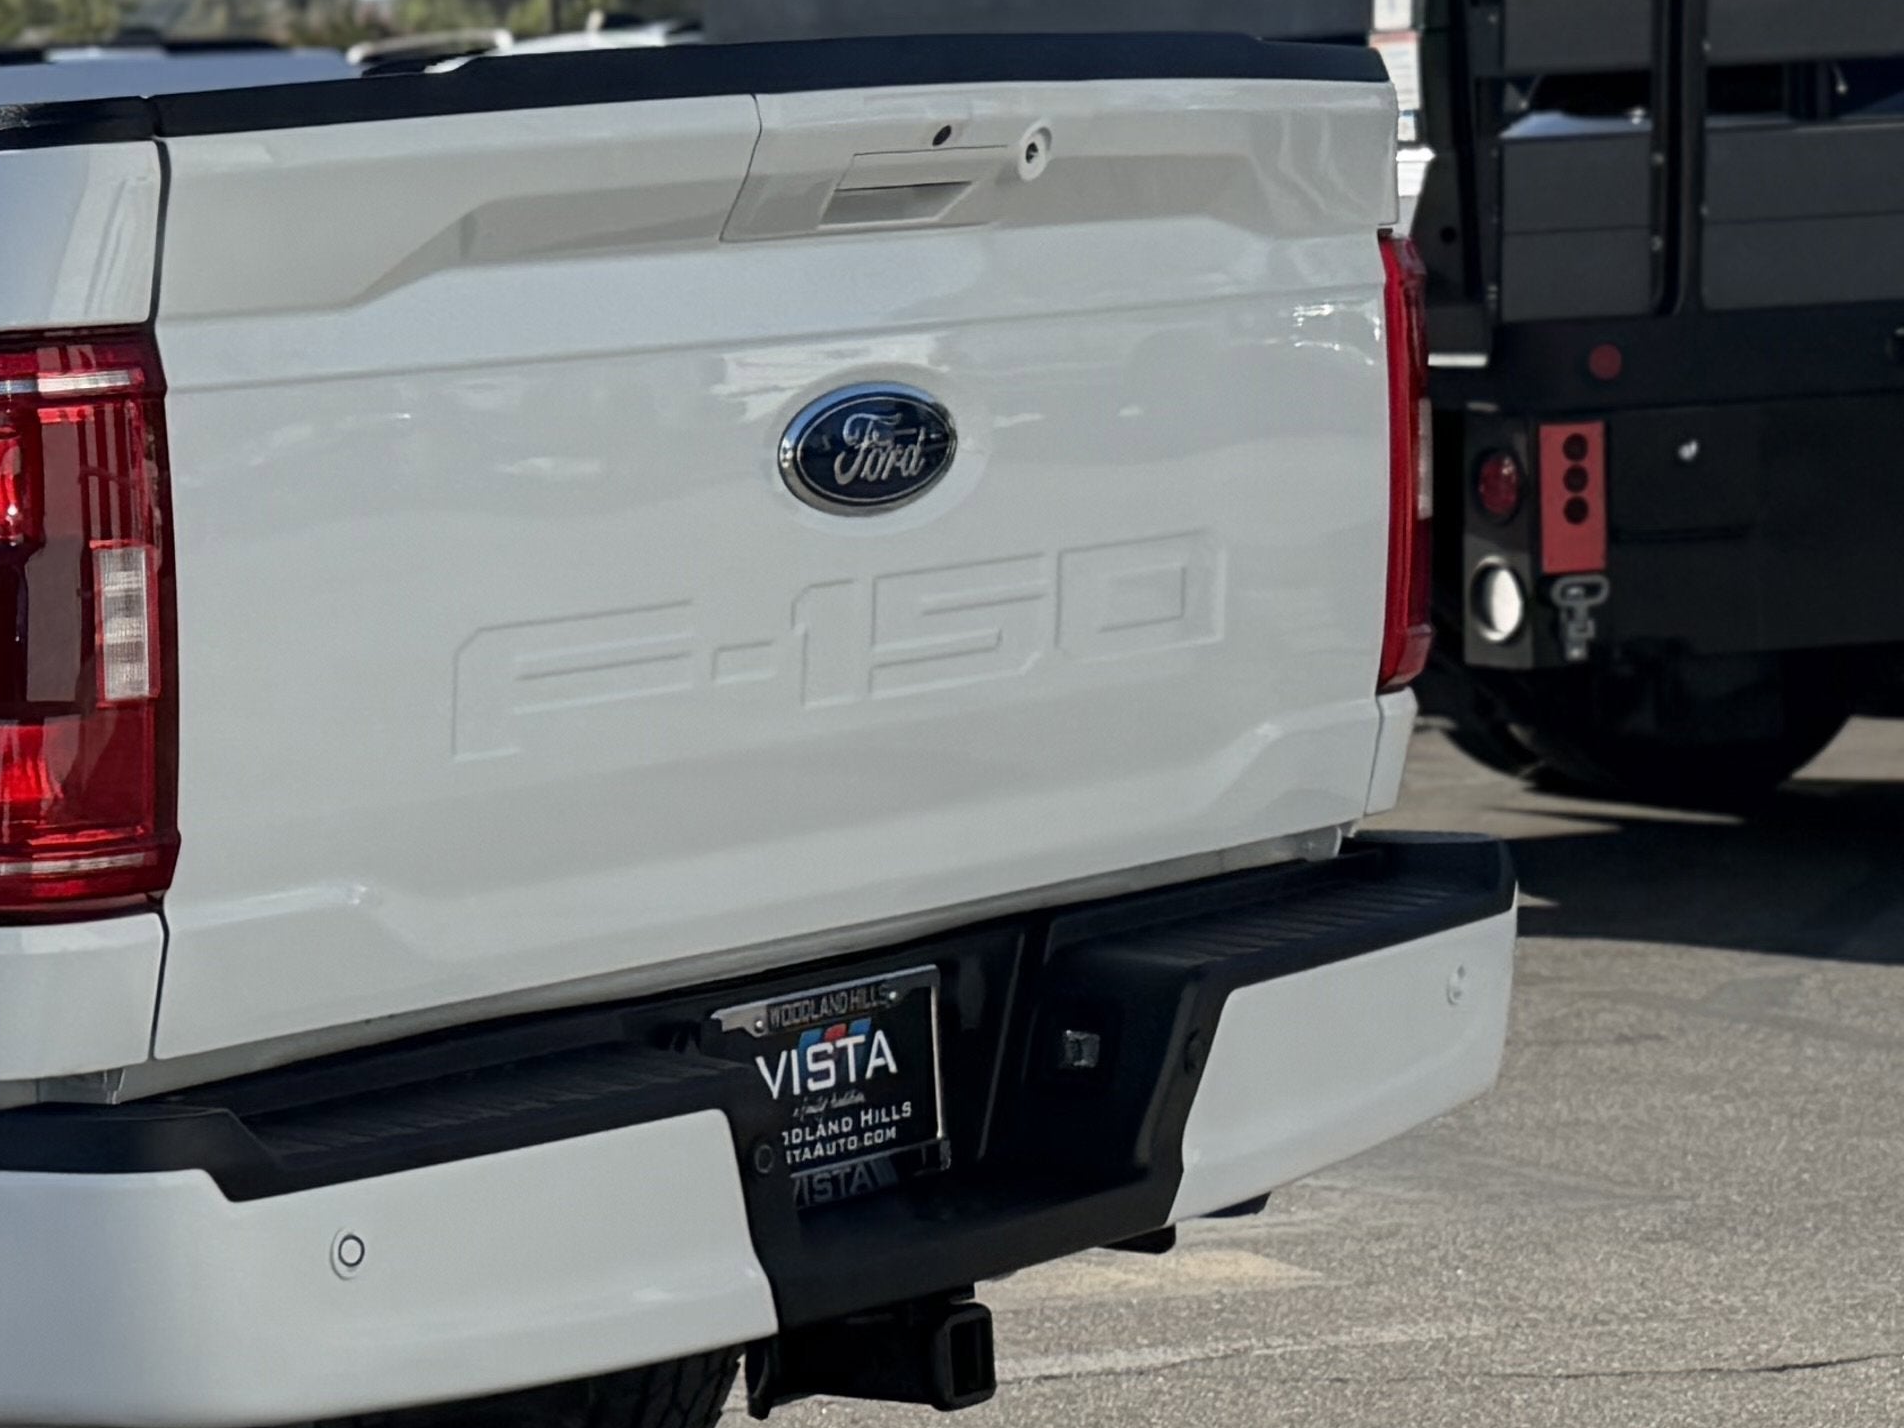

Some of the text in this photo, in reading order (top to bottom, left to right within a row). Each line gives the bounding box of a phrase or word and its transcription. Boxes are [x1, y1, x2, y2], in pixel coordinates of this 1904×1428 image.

[832, 412, 925, 485] Ford
[451, 527, 1228, 762] F-150
[755, 1029, 898, 1100] VISTA
[861, 1101, 912, 1128] HILLS
